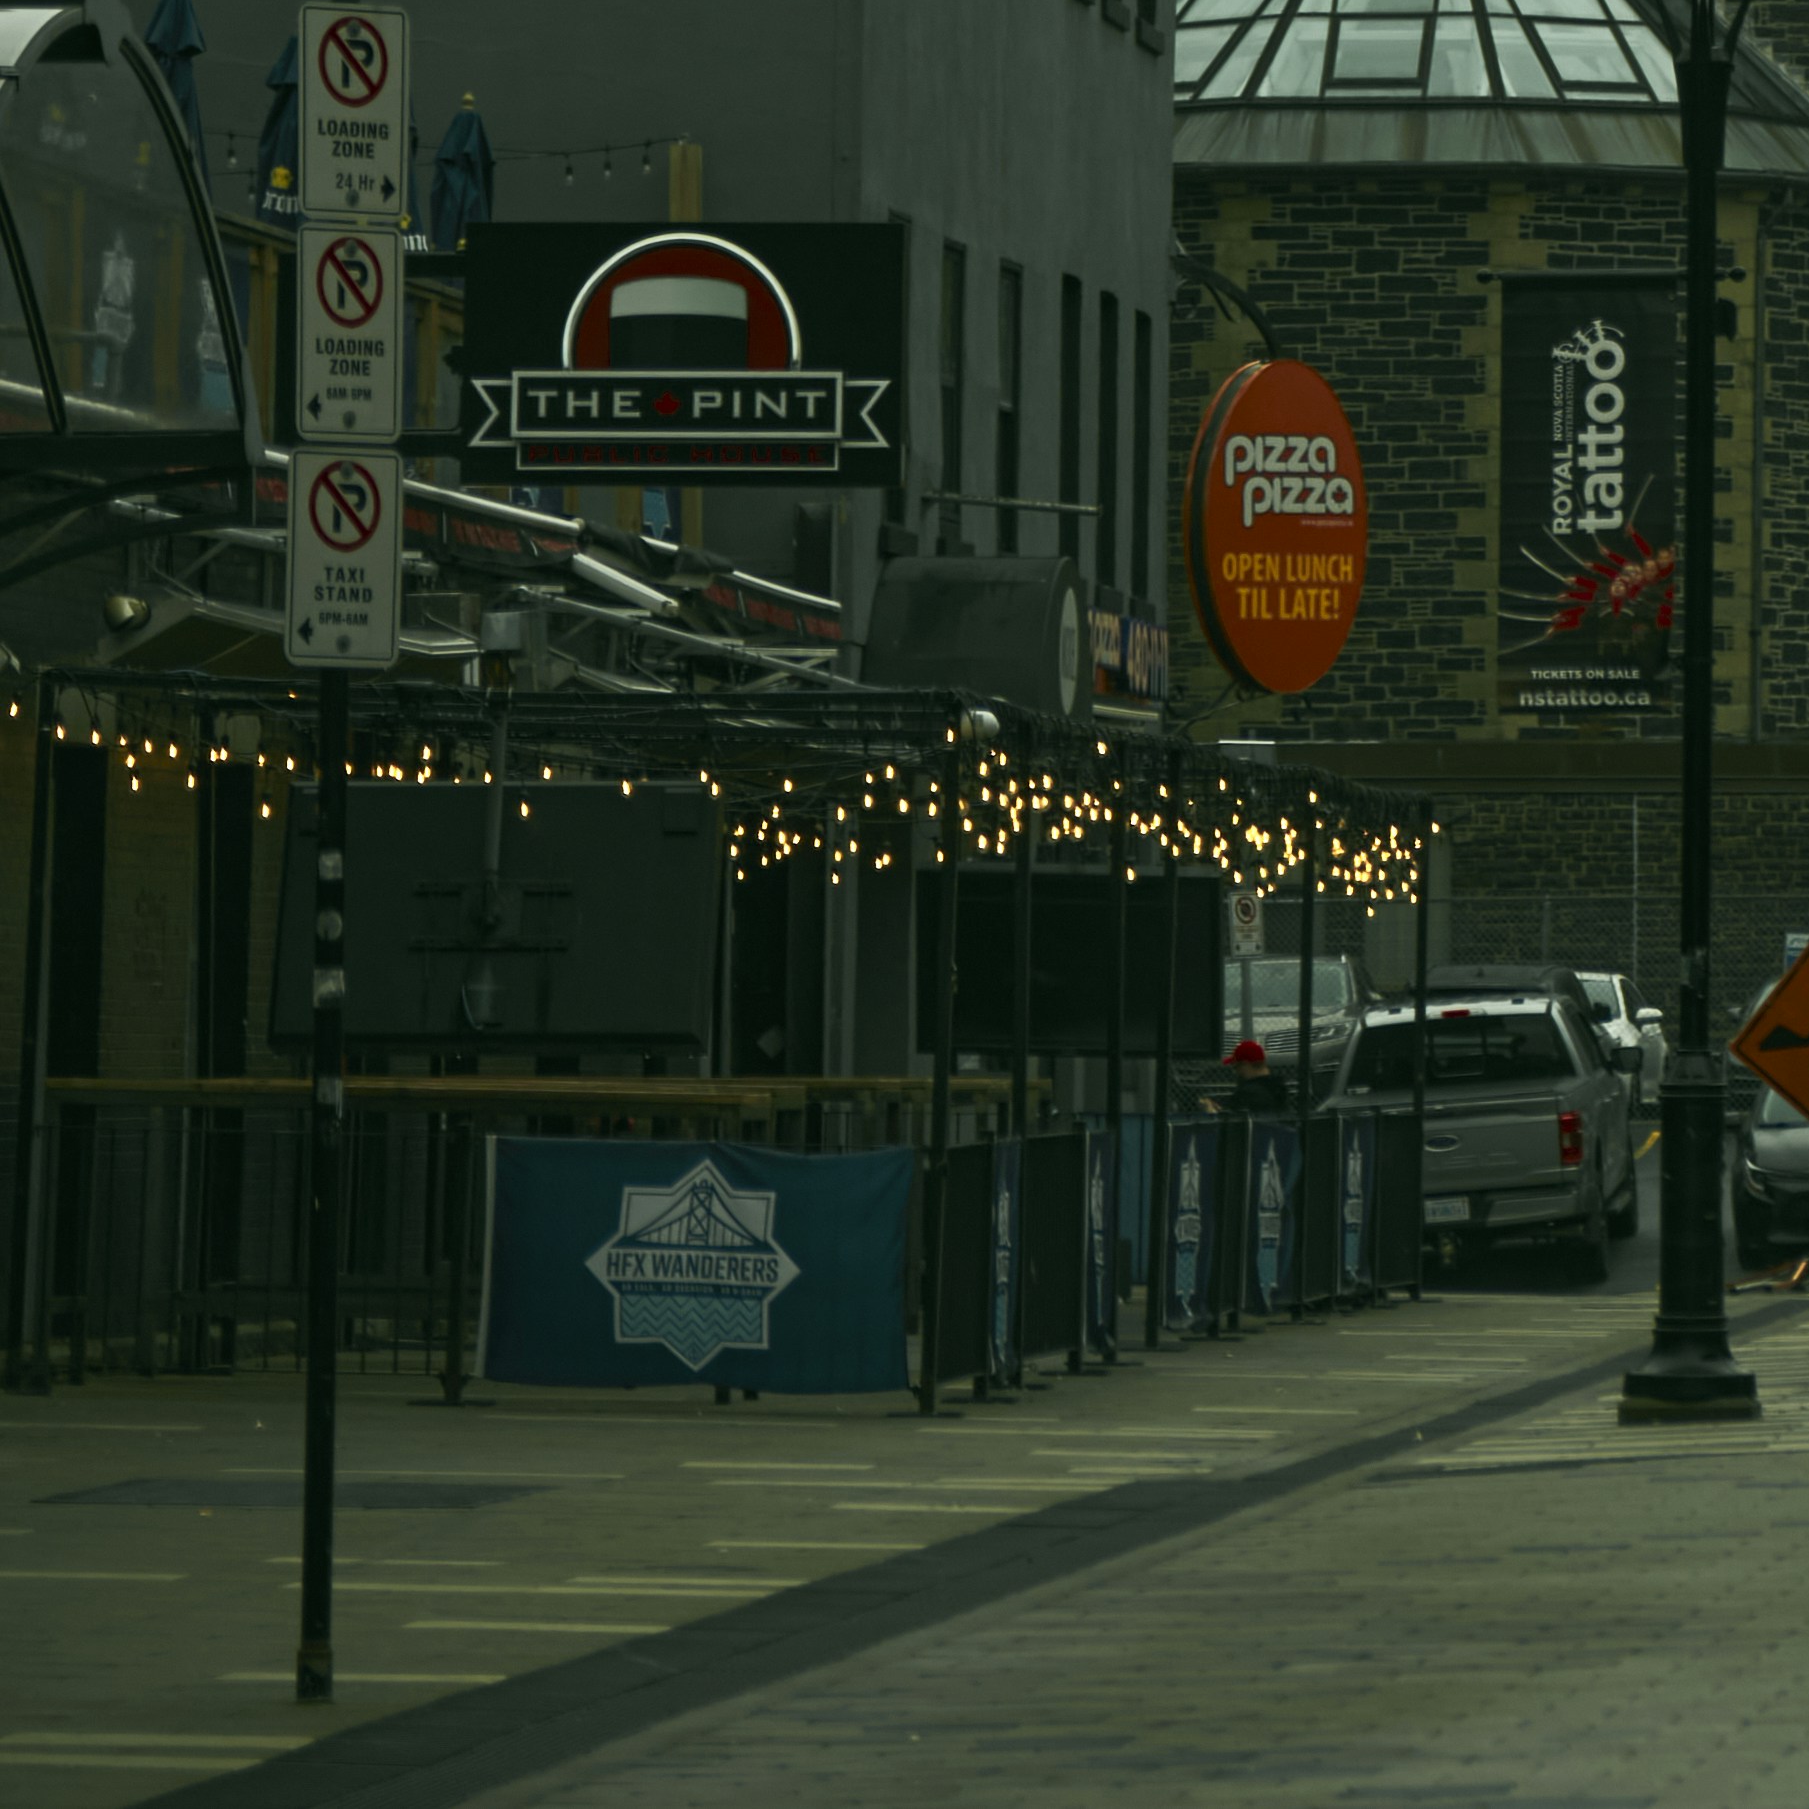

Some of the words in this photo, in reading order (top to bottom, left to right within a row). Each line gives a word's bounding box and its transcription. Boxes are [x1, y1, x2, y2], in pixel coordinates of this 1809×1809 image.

[318, 119, 389, 140] LOADING
[333, 141, 375, 159] ZONE
[336, 174, 354, 190] 24
[358, 174, 375, 191] Hr
[316, 339, 385, 357] LOADING
[330, 358, 370, 376] ZONE
[1553, 364, 1563, 407] SCOTIA
[526, 390, 642, 419] THE
[692, 390, 827, 419] PINT
[1565, 364, 1575, 442] INTERNATIONAL
[1553, 409, 1563, 442] NOVA
[1576, 338, 1626, 535] tattoo
[529, 445, 668, 463] PUBLIC
[690, 445, 826, 464] HOUSE
[1224, 434, 1338, 488] pizza
[1242, 475, 1355, 528] pizza
[1552, 444, 1574, 535] ROYAL
[325, 567, 365, 583] TAXI
[1221, 551, 1281, 583] OPEN
[1285, 552, 1355, 584] LUNCH
[314, 586, 373, 604] STAND
[1235, 586, 1274, 621] TIL
[1278, 586, 1341, 621] LATE!
[1530, 668, 1583, 681] TICKETS
[1586, 668, 1606, 681] ON
[1608, 668, 1641, 681] SALE
[1518, 687, 1653, 708] nstattoo.ca
[606, 1252, 647, 1278] HFX
[651, 1253, 779, 1284] WANDERERS
